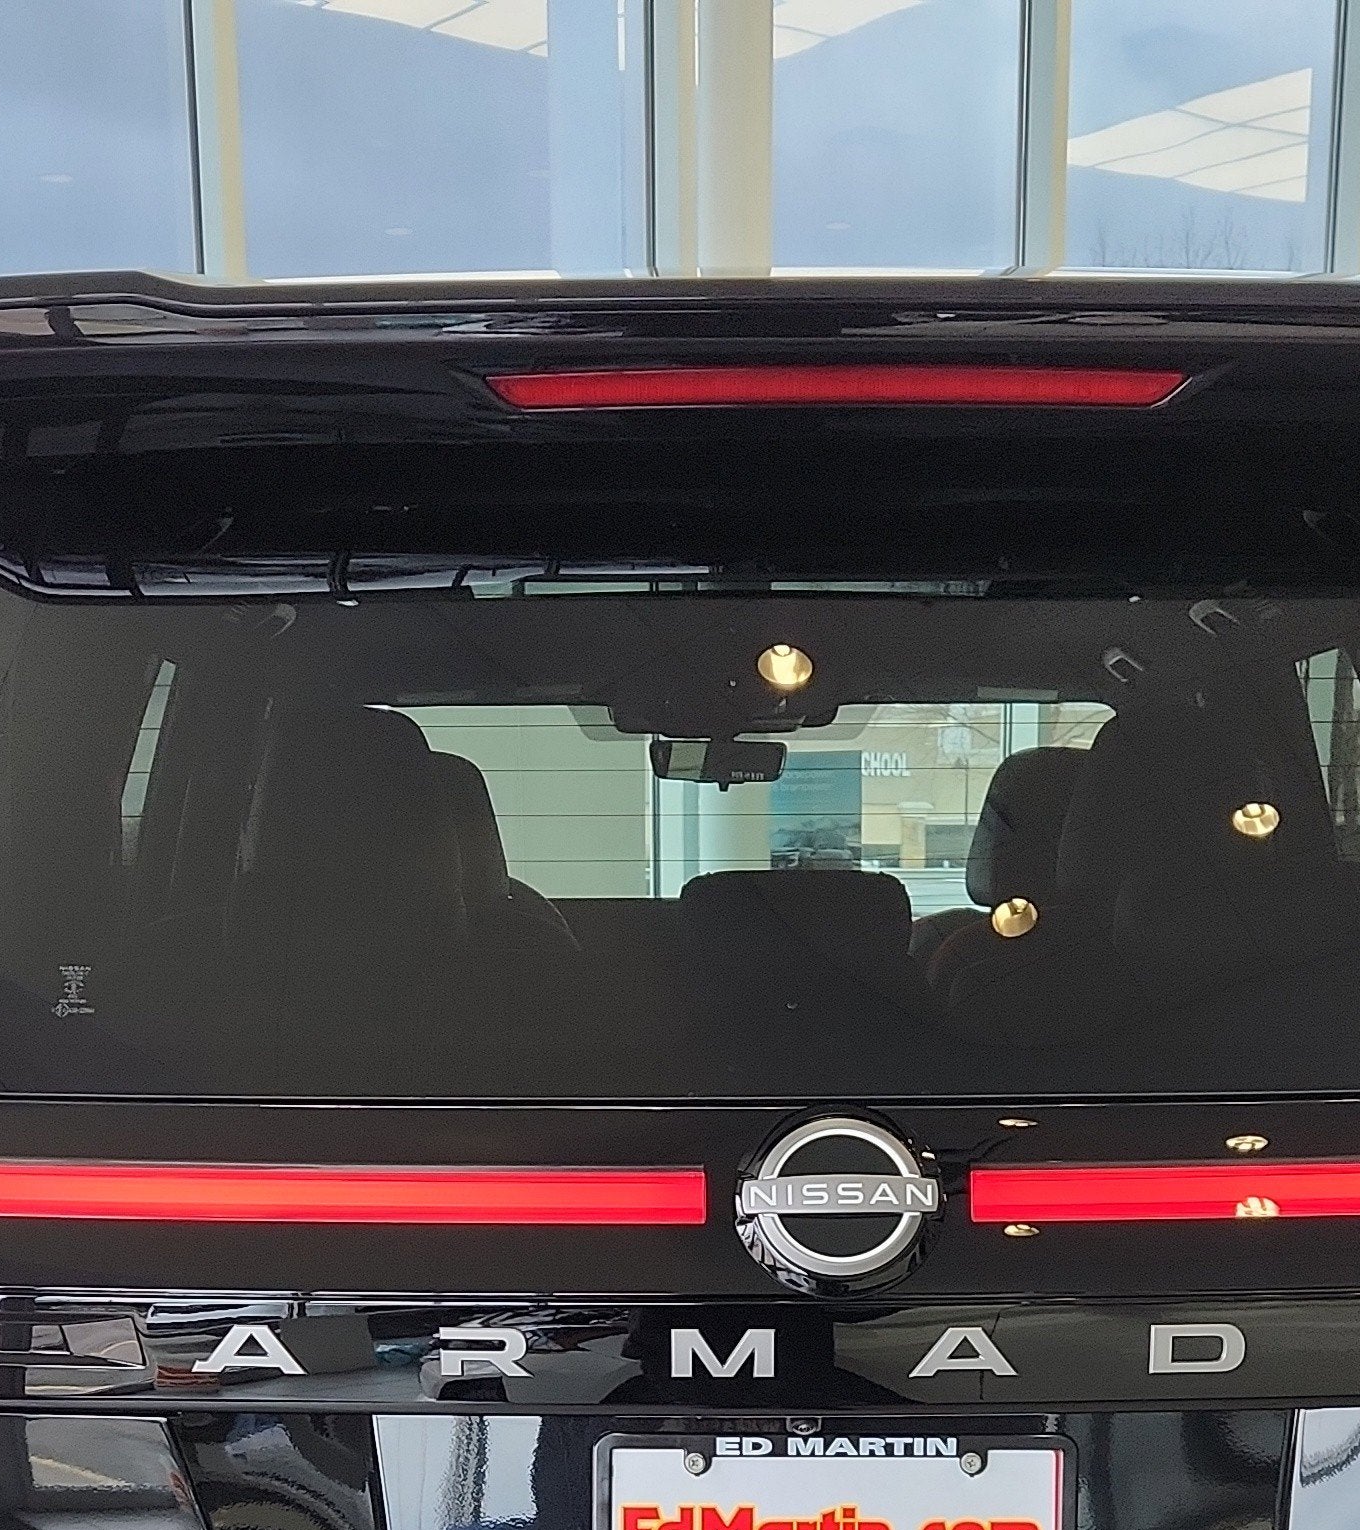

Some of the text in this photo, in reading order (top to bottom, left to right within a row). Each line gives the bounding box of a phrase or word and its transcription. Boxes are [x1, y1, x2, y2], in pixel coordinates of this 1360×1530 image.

[861, 751, 911, 777] CHOOL
[749, 1182, 933, 1207] NISSAN
[715, 1437, 958, 1456] ED MARTIN
